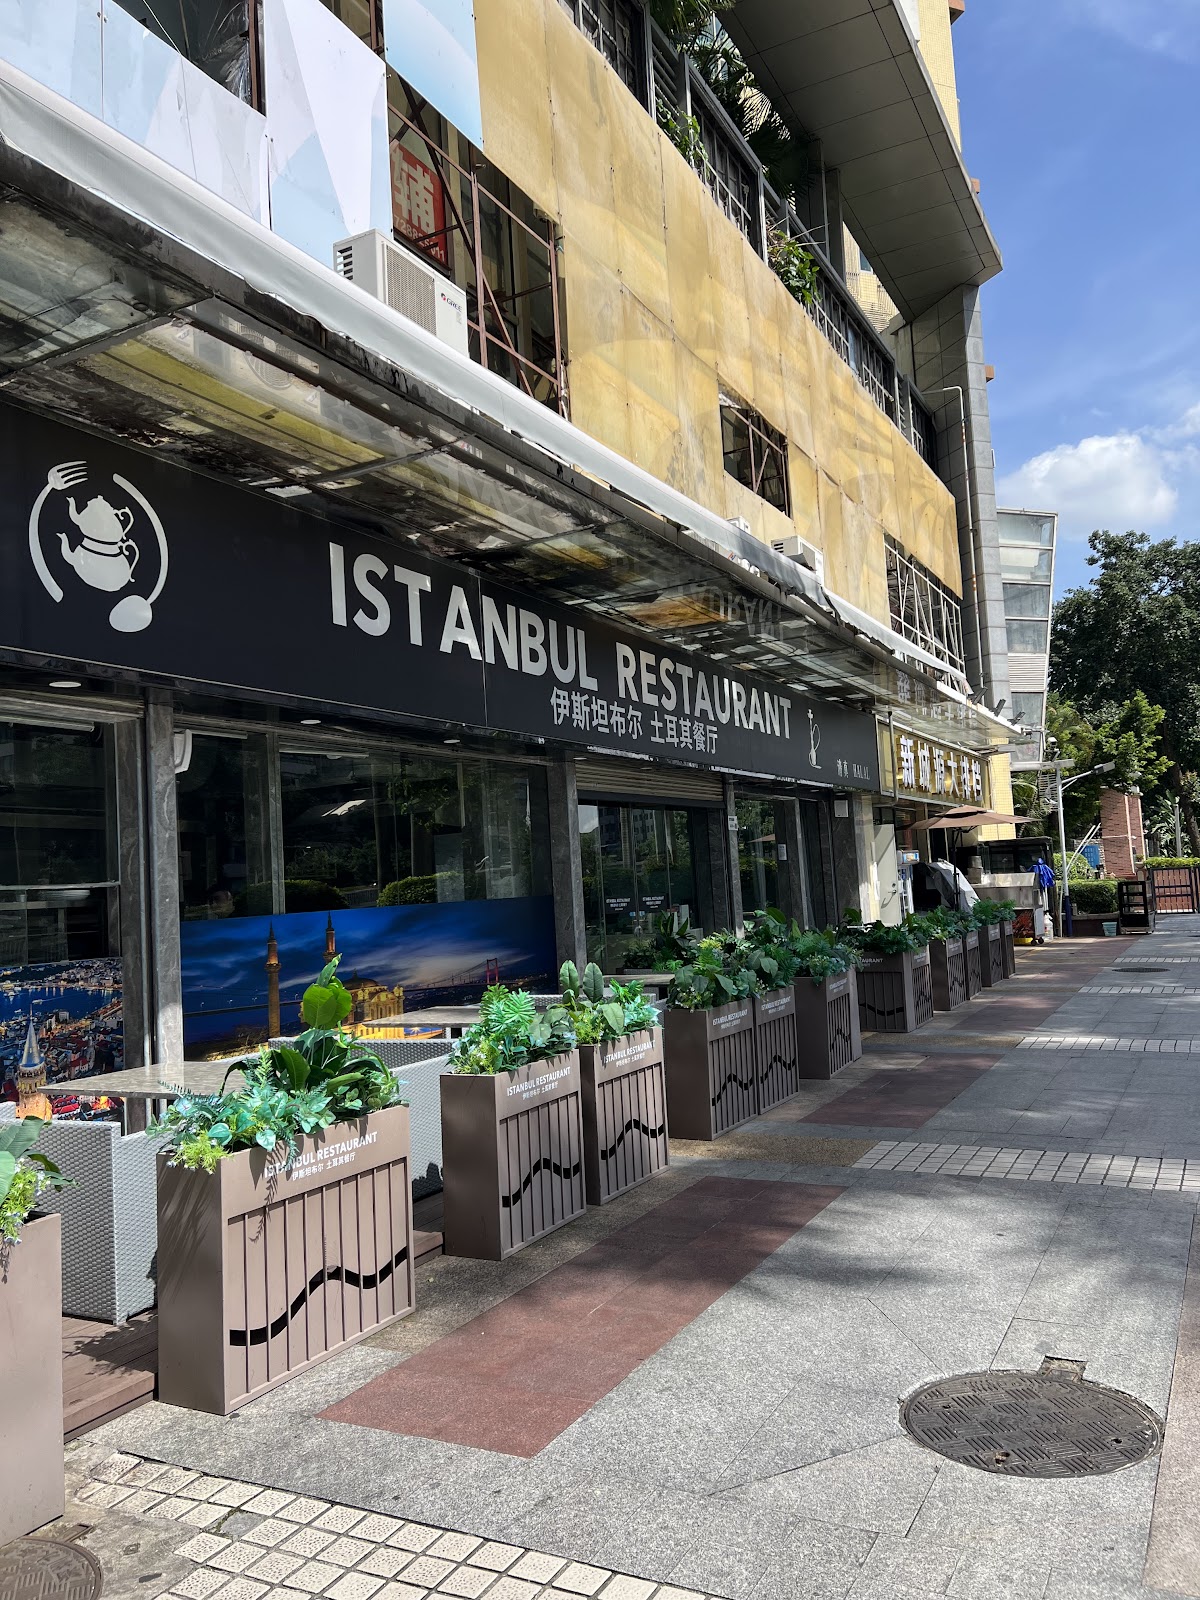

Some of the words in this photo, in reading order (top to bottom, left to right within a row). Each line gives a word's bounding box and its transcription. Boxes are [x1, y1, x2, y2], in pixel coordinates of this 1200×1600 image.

[446, 297, 463, 313] GREE
[328, 541, 599, 691] ISTANBUL
[616, 641, 792, 741] RESTAURANT
[550, 685, 644, 741] 伊斯坦布尔
[650, 710, 719, 756] 土耳其餐厅
[836, 758, 849, 779] 清真
[852, 763, 871, 781] HALAL
[604, 1050, 627, 1064] ISTANBUL
[626, 1040, 656, 1057] RESTAURANT
[507, 1078, 536, 1097] ISTANBUL
[535, 1066, 571, 1087] RESTAURANT
[316, 1131, 378, 1161] RESTAURANT
